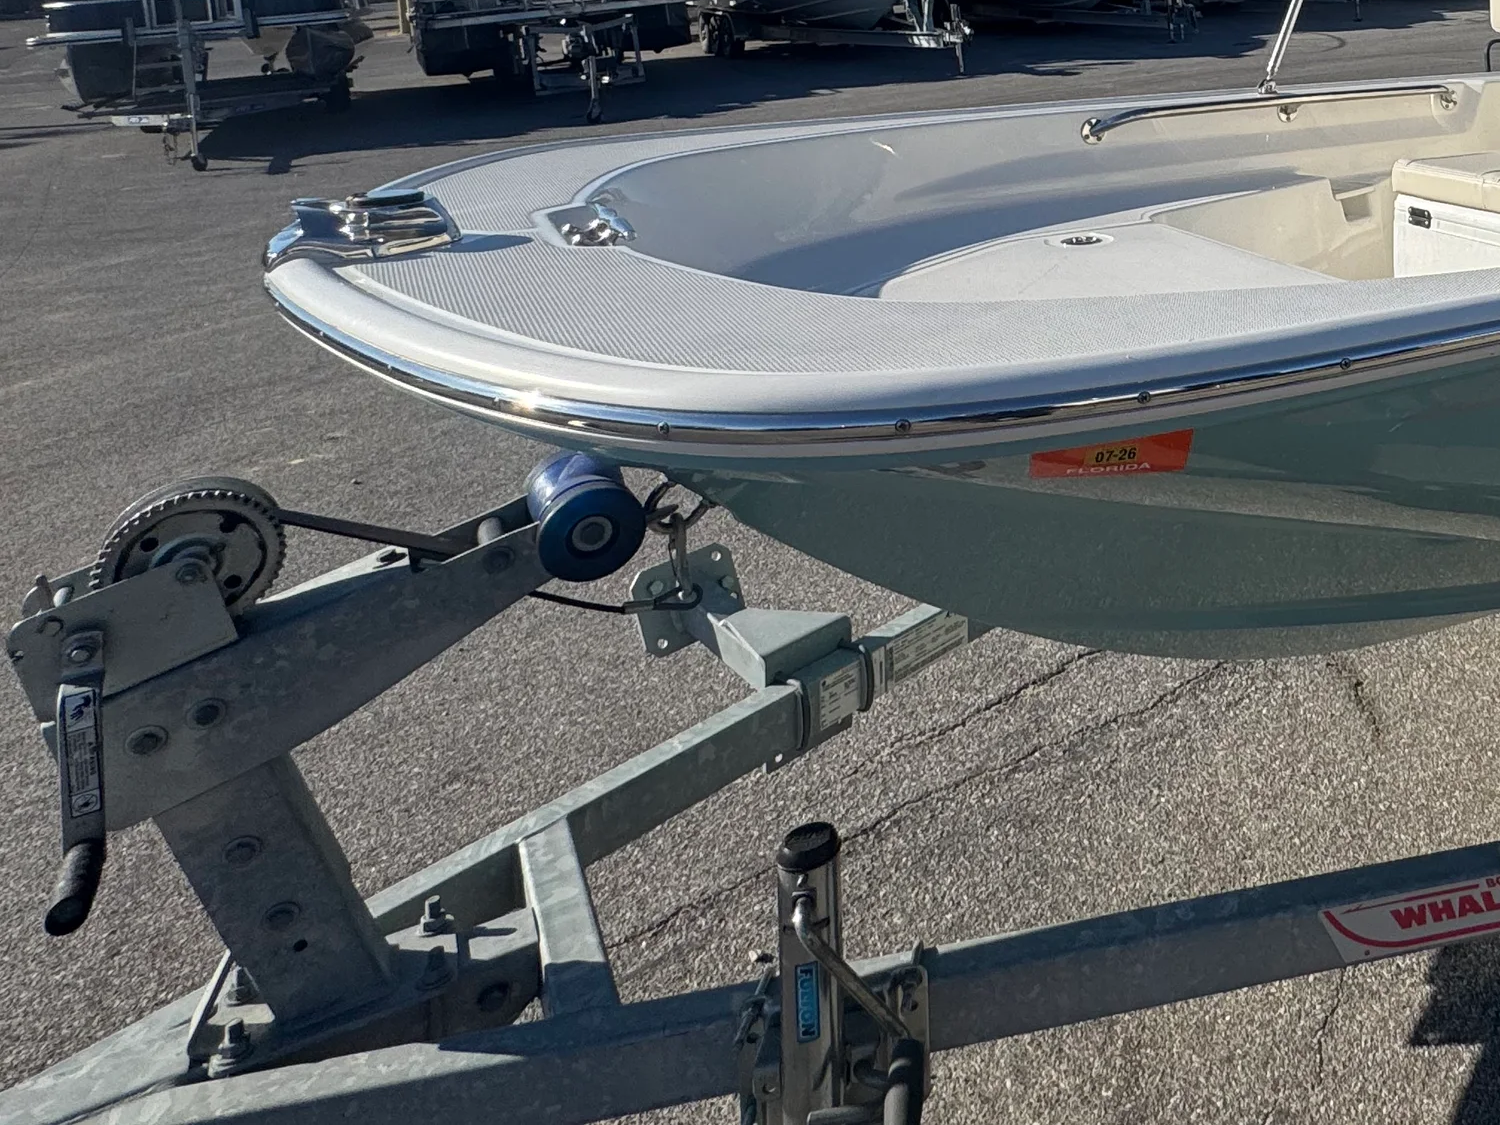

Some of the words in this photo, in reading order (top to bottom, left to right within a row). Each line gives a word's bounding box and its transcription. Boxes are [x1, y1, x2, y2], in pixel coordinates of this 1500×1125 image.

[1095, 447, 1137, 463] 07-26
[1066, 462, 1151, 475] FLORIDA
[799, 967, 816, 1037] FULTON
